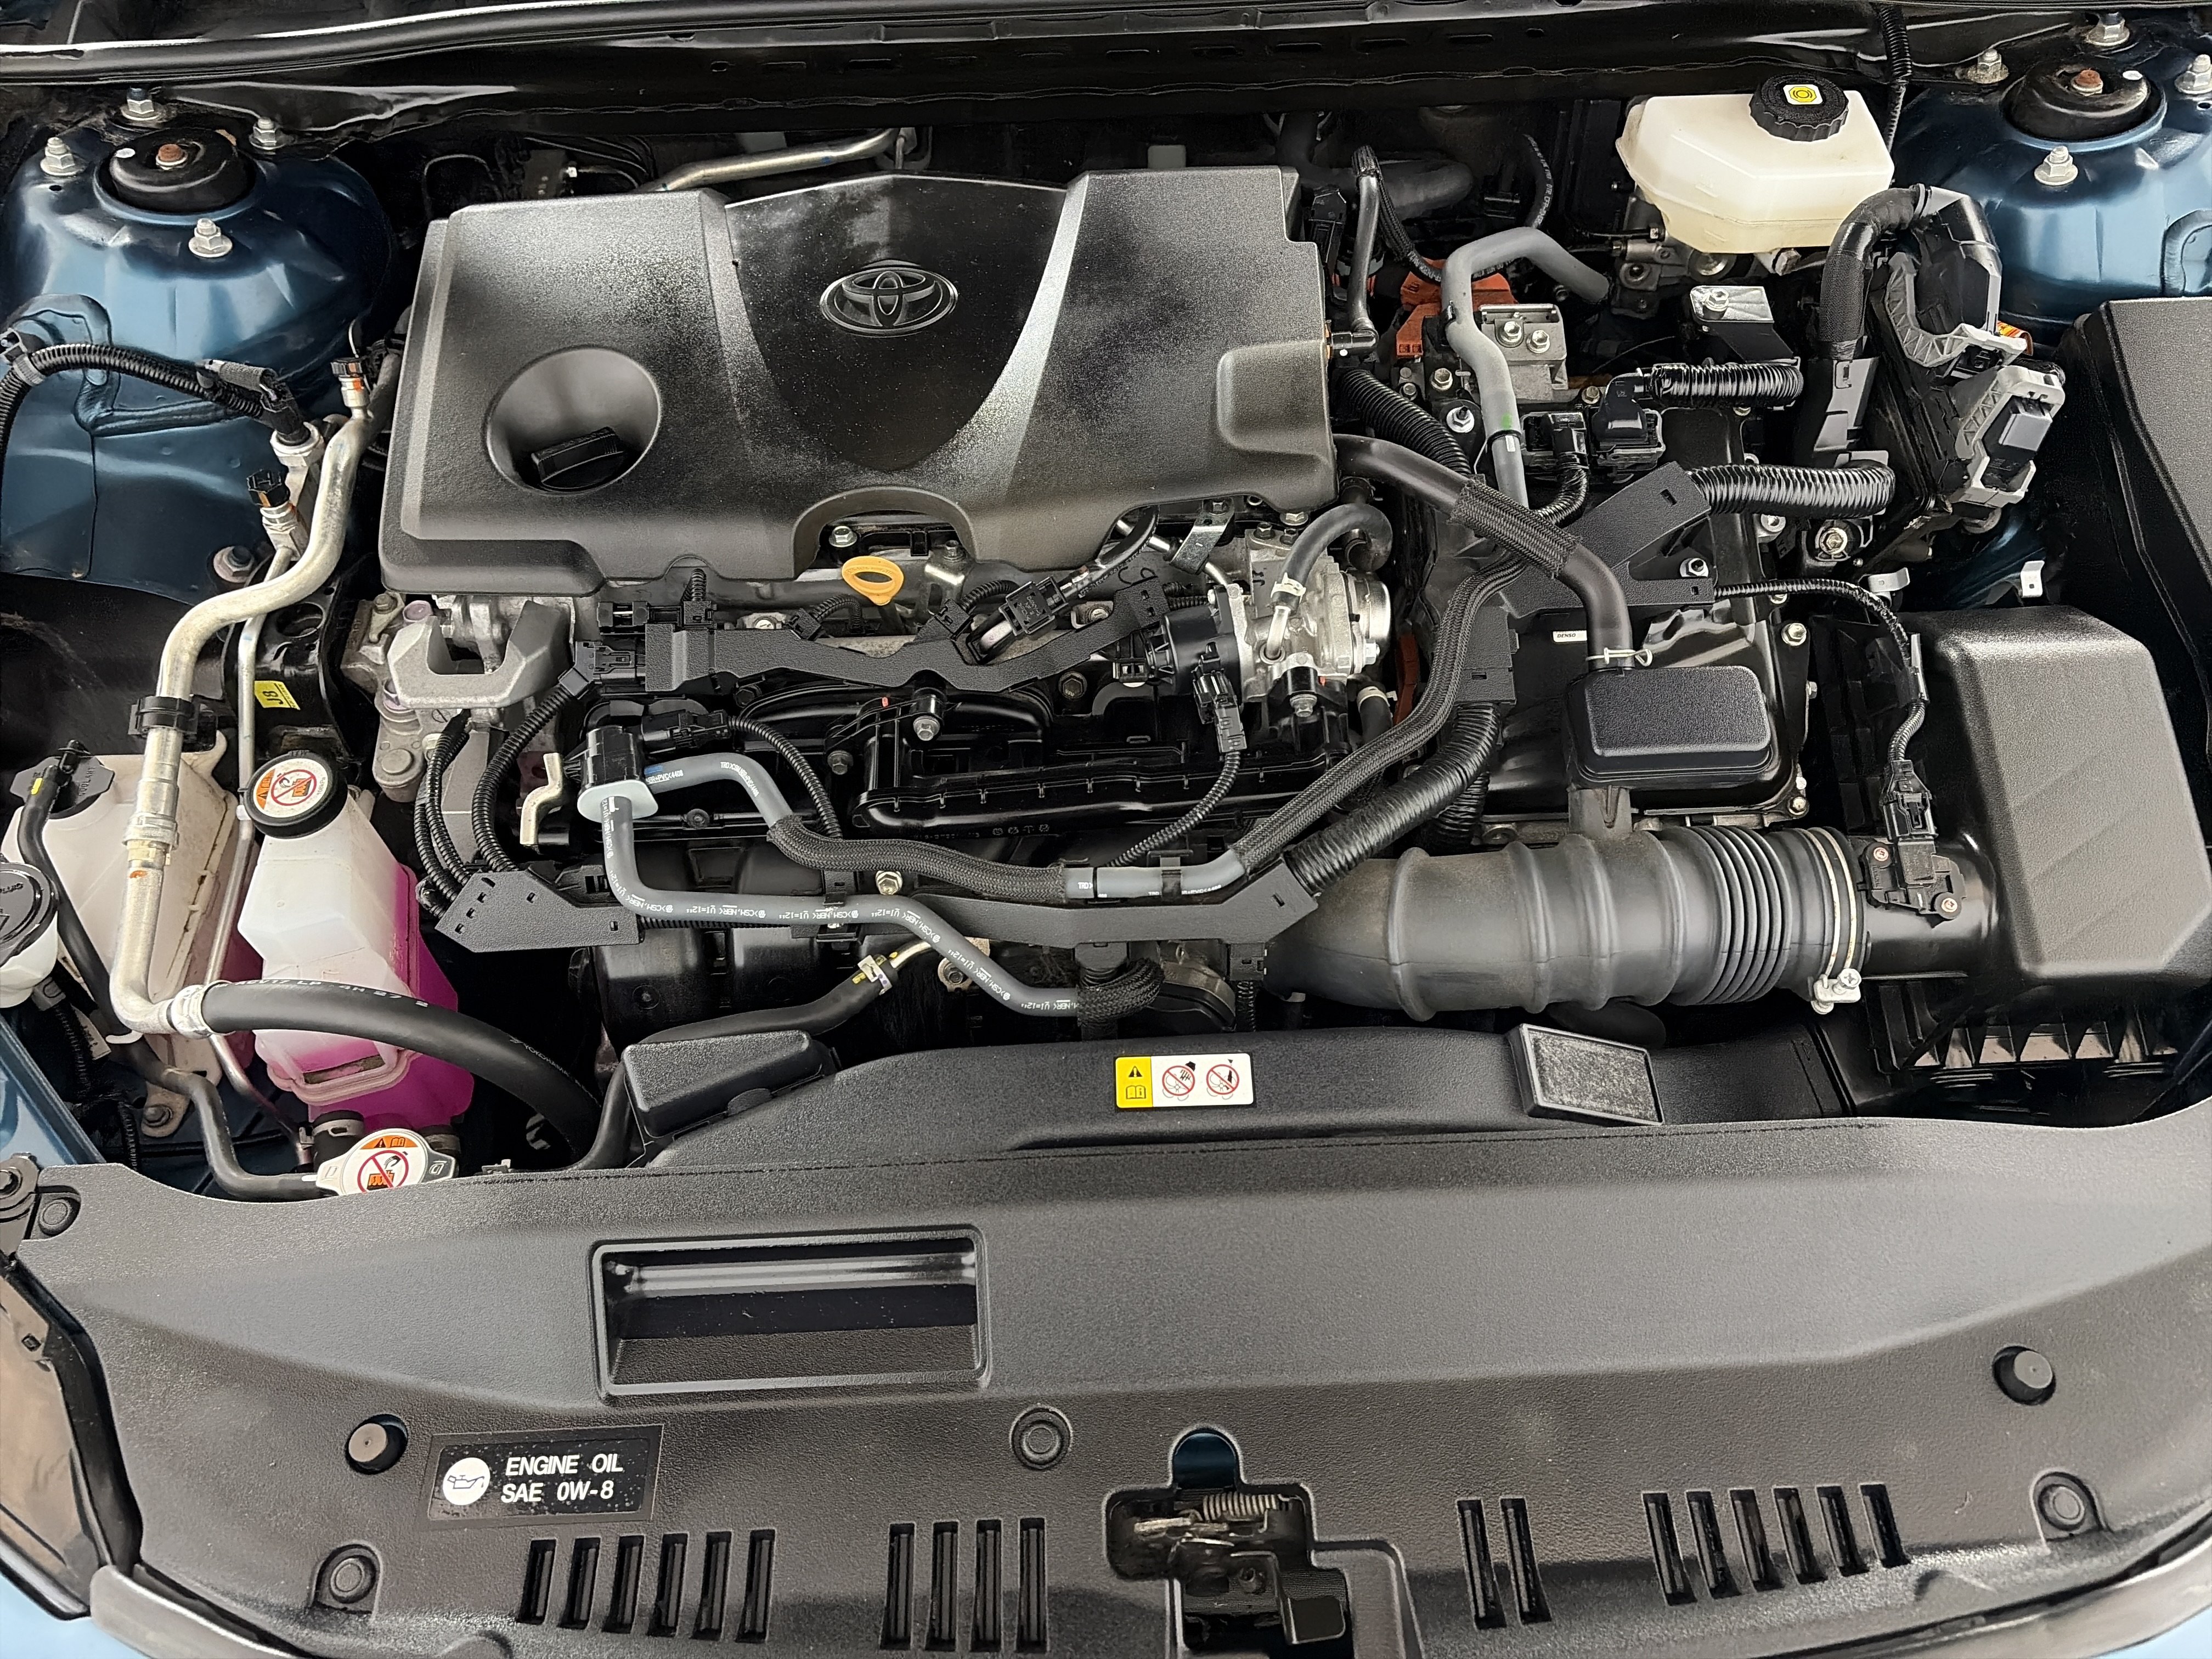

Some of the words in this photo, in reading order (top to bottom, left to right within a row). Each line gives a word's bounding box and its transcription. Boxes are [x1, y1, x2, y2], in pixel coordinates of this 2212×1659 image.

[262, 690, 284, 704] J8
[505, 1454, 580, 1476] ENGINE
[591, 1453, 624, 1473] OIL
[500, 1482, 544, 1504] SAE
[556, 1480, 614, 1501] 0W-8
